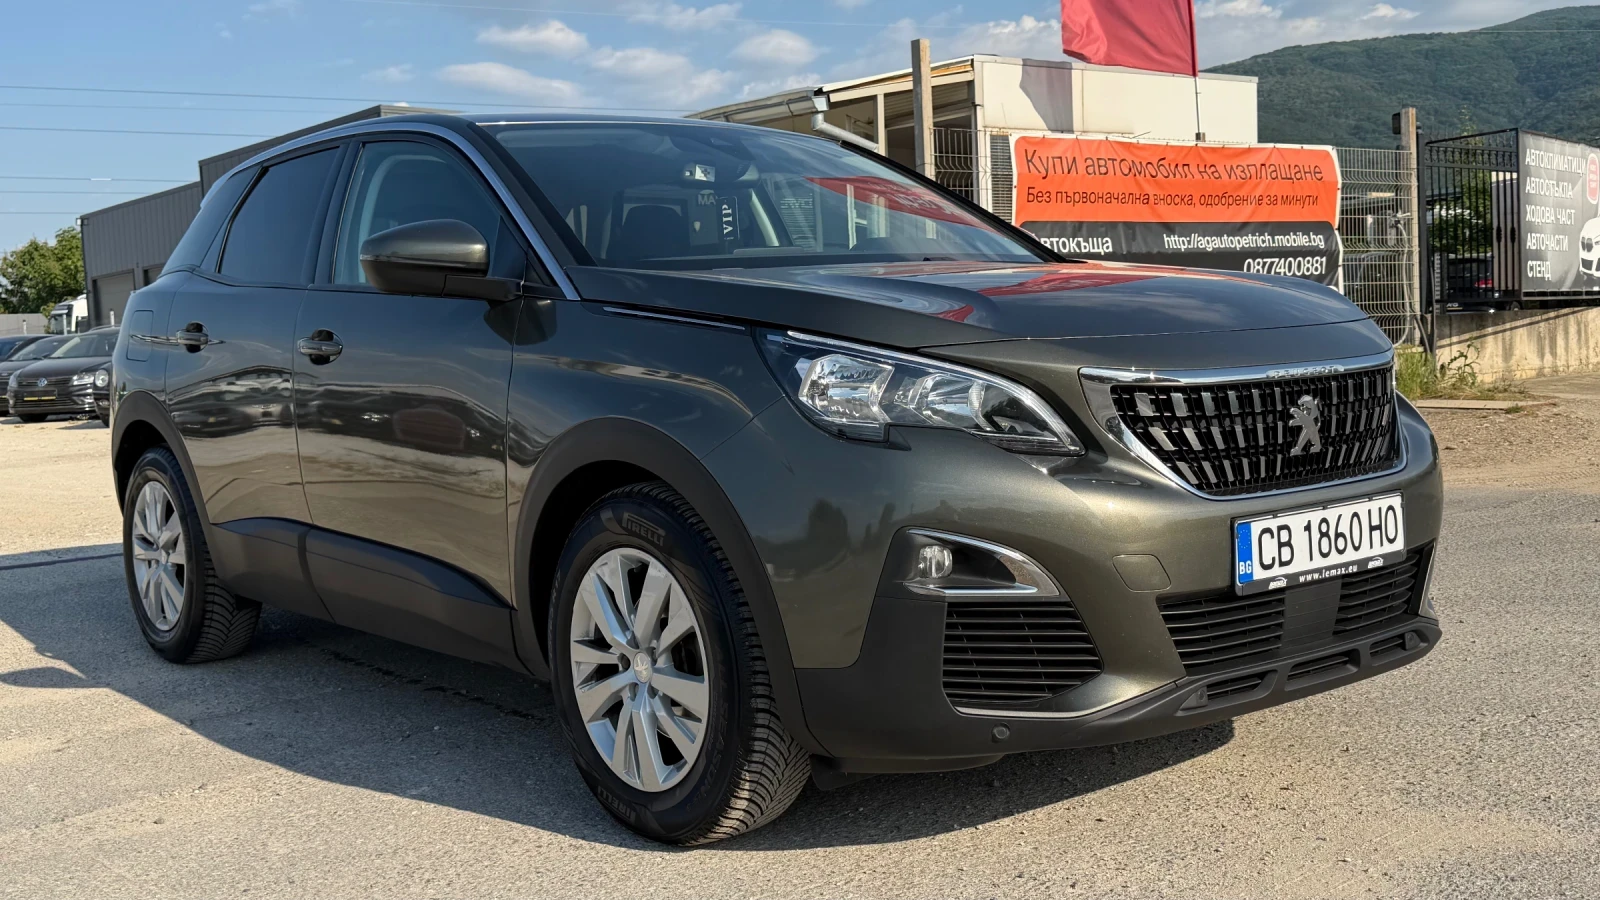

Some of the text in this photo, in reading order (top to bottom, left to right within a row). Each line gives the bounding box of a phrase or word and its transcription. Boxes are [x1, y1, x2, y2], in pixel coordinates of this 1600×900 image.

[1024, 149, 1324, 184] Купи автомобил на изплащане
[1525, 148, 1586, 176] АВТОКЛИМАТИЦИ
[1026, 186, 1318, 209] Без първоначална вноска, одобрение за минути
[1525, 177, 1573, 198] АВТОСТЪКЛА
[721, 204, 734, 235] VIP
[1525, 204, 1575, 225] ХОДОВА ЧАСТ
[1040, 237, 1113, 256] втокъща
[1163, 232, 1325, 251] http://agautopetrich.mobile.bg
[1526, 232, 1568, 252] АВТОЧАСТИ
[1243, 256, 1327, 276] 0877400881
[1527, 260, 1551, 281] СТЕНД
[1273, 365, 1335, 379] PEUGEOT
[621, 512, 667, 547] PIRELLI
[1257, 504, 1399, 571] CB 1860 HO
[1239, 560, 1252, 574] BG
[596, 785, 637, 826] PIRELLI
